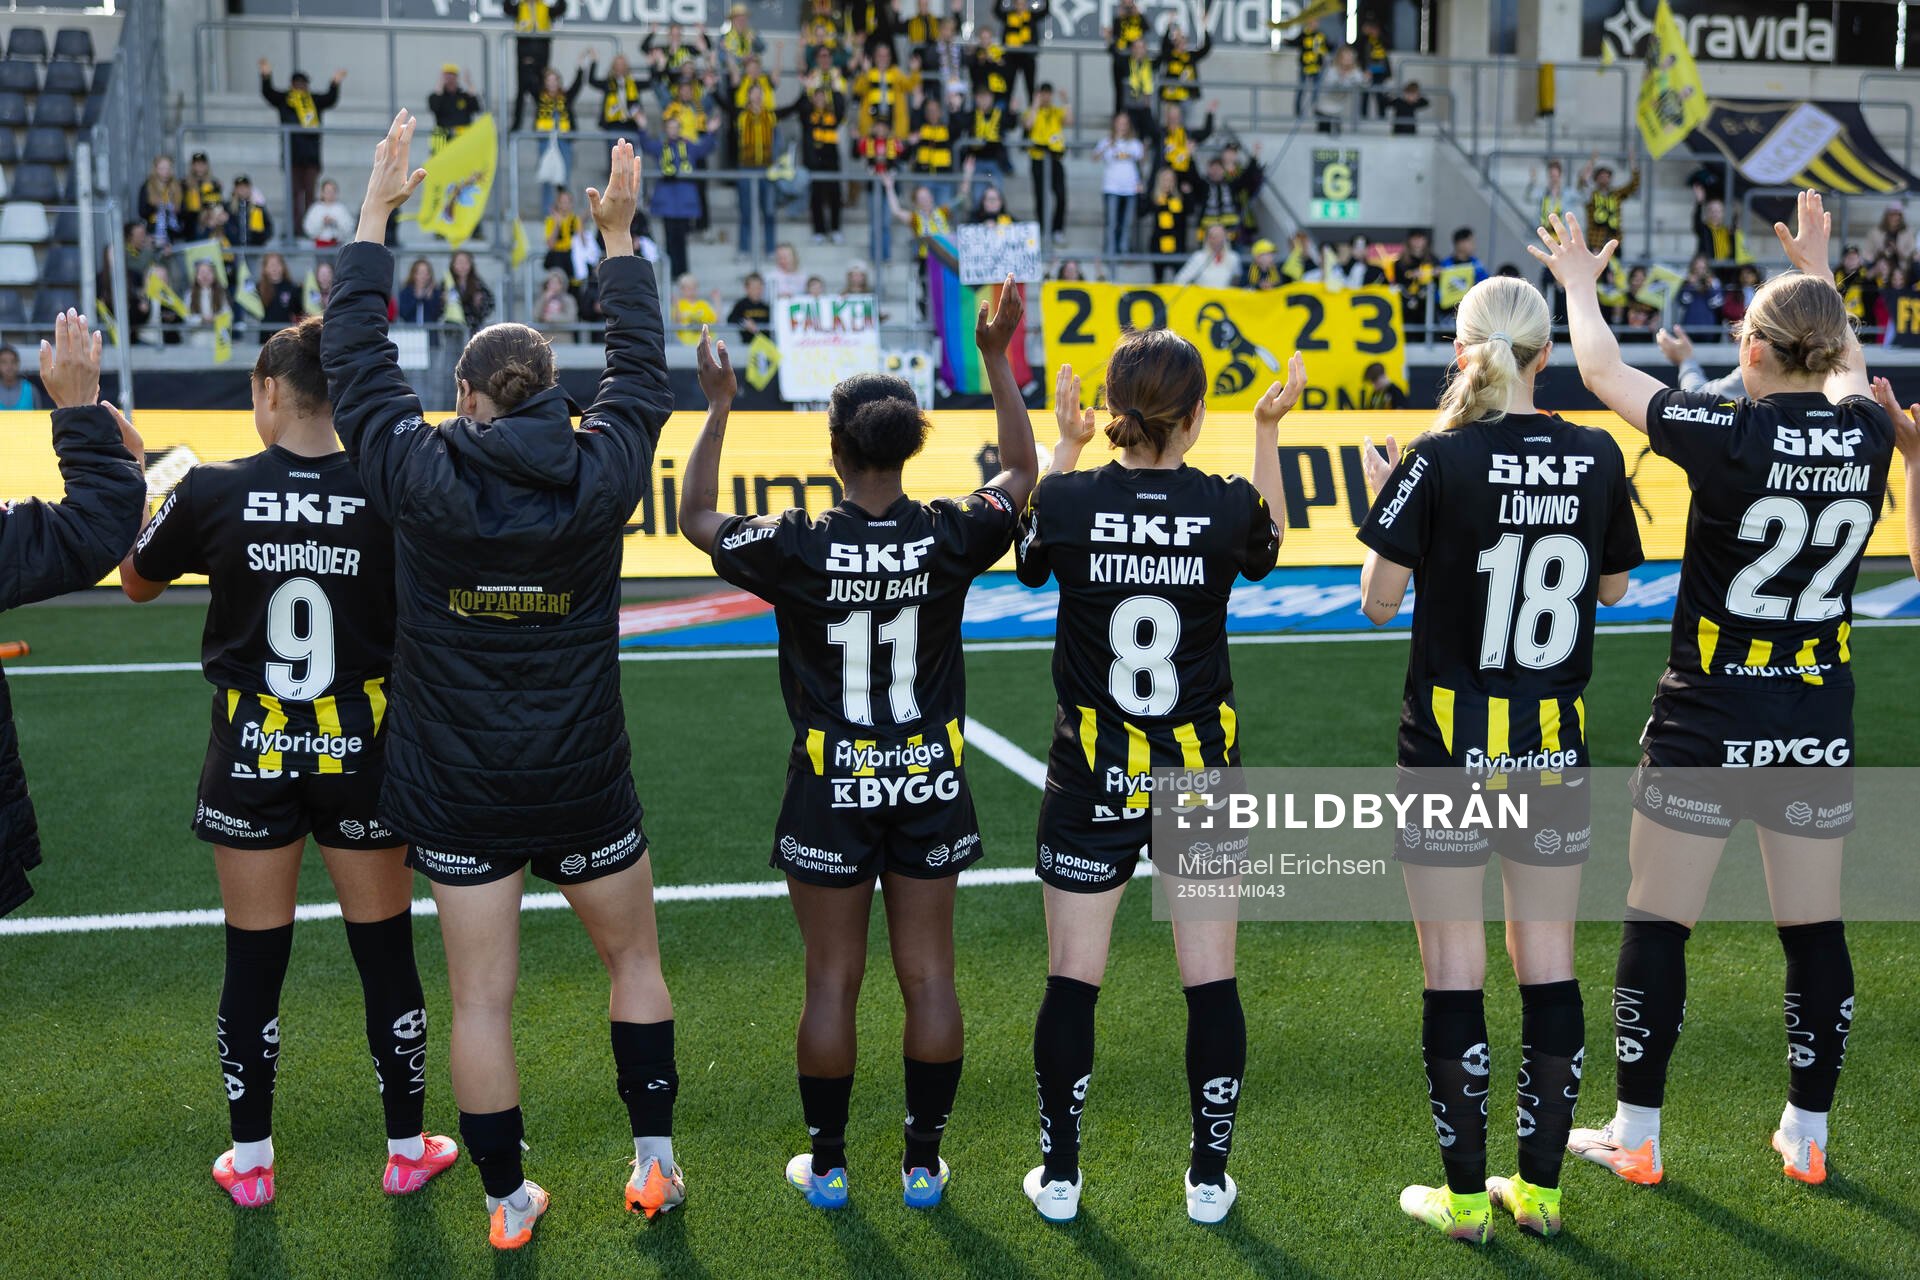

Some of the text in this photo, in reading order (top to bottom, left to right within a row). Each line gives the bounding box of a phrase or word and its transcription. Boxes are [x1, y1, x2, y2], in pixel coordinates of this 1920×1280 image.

[1322, 163, 1353, 201] G
[1662, 403, 1734, 425] stadium
[1774, 426, 1863, 457] SKF
[288, 471, 321, 480] HISINGEN
[1489, 454, 1594, 485] SKF
[1767, 462, 1870, 492] NYSTRÖM
[1136, 492, 1167, 501] HISINGEN
[1376, 452, 1428, 528] stadium
[137, 490, 176, 553] stadium
[244, 492, 365, 525] SKF
[1499, 490, 1579, 524] LÖWING
[719, 524, 777, 549] stadium
[1091, 513, 1210, 545] SKF
[248, 540, 360, 578] SCHRÖDER
[826, 536, 934, 575] SKF
[1090, 554, 1204, 584] KITAGAWA
[1725, 496, 1873, 622] 22
[449, 588, 571, 616] KOPPARBERG
[518, 585, 543, 593] CIDER
[827, 570, 929, 602] JUSU BAH
[1477, 533, 1588, 669] 18
[266, 577, 335, 701] 9
[1109, 595, 1180, 715] 8
[828, 605, 921, 725] 11
[242, 721, 362, 758] Hybridge
[835, 738, 946, 773] Hybridge
[1466, 747, 1578, 779] Hybridge
[1106, 765, 1221, 796] Hybridge
[591, 826, 638, 860] NORDISK
[1425, 828, 1480, 843] NORDISK
[1055, 852, 1111, 874] NORDISK
